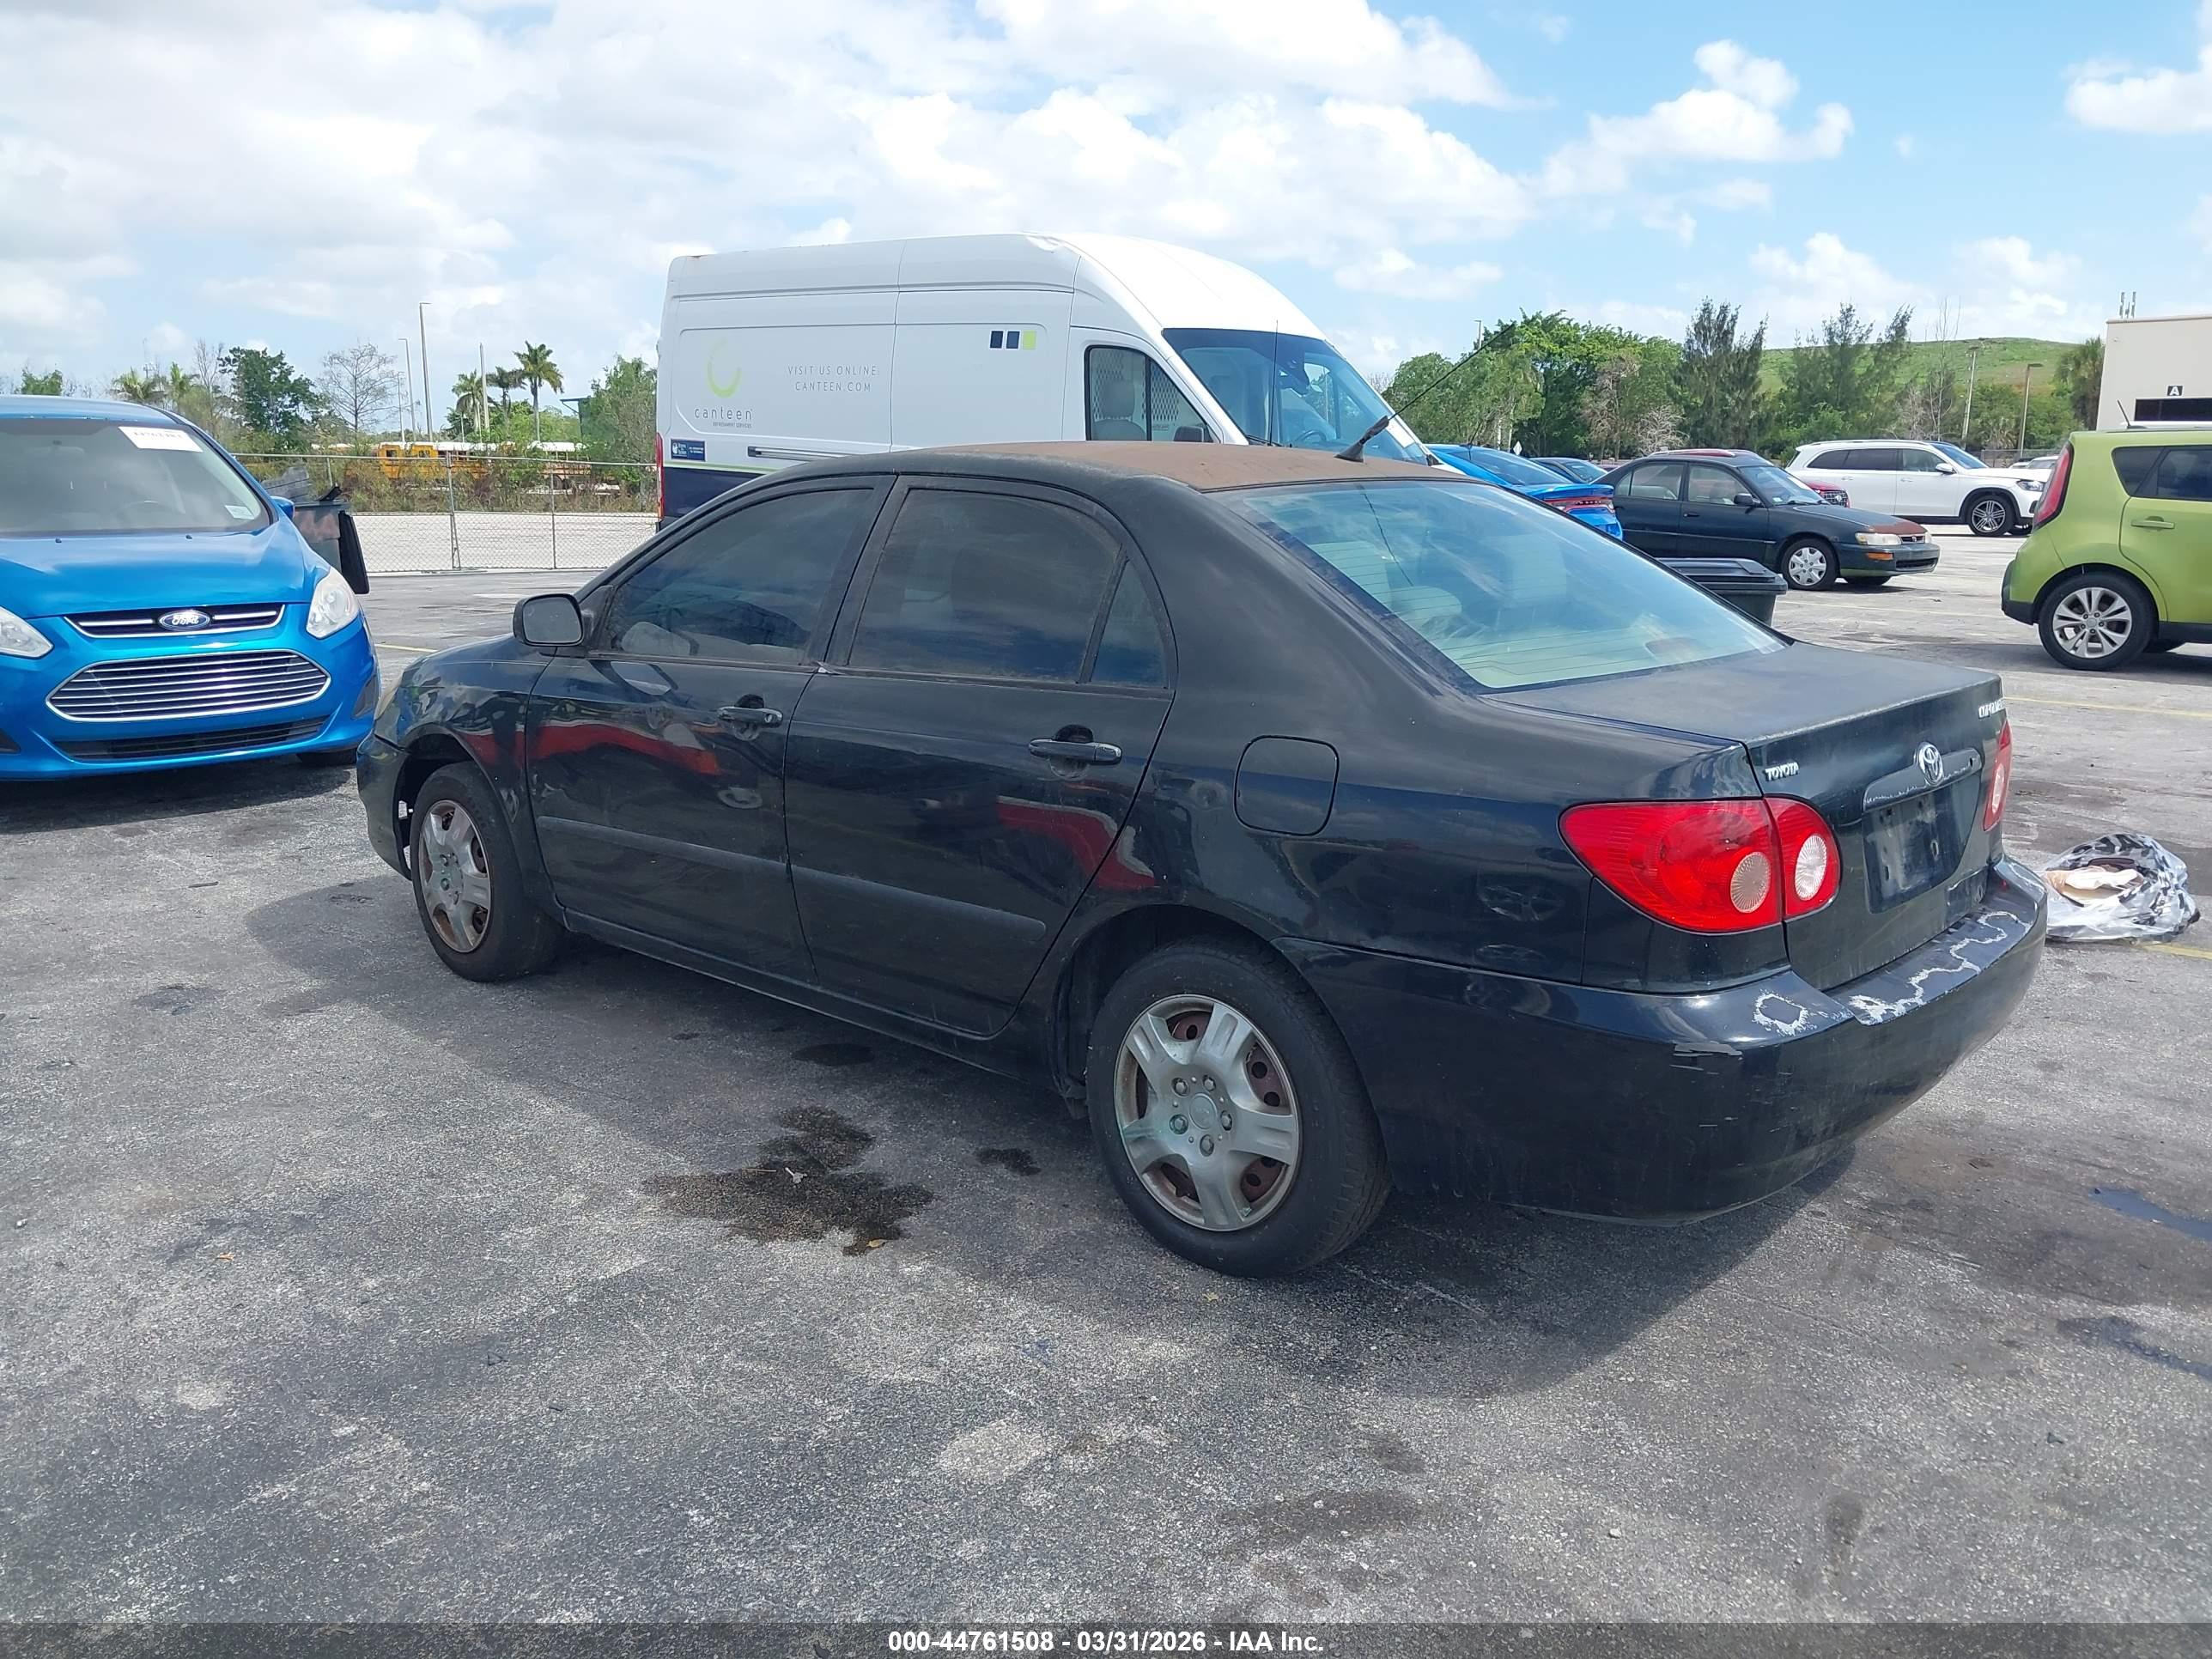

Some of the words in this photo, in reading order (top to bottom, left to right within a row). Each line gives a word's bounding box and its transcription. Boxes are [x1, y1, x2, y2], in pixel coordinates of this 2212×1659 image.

[787, 365, 814, 375] VISIT
[819, 365, 831, 375] US
[2169, 386, 2180, 396] A
[694, 406, 752, 420] canteen
[172, 613, 199, 625] Ford
[1765, 762, 1800, 781] TOYOTA
